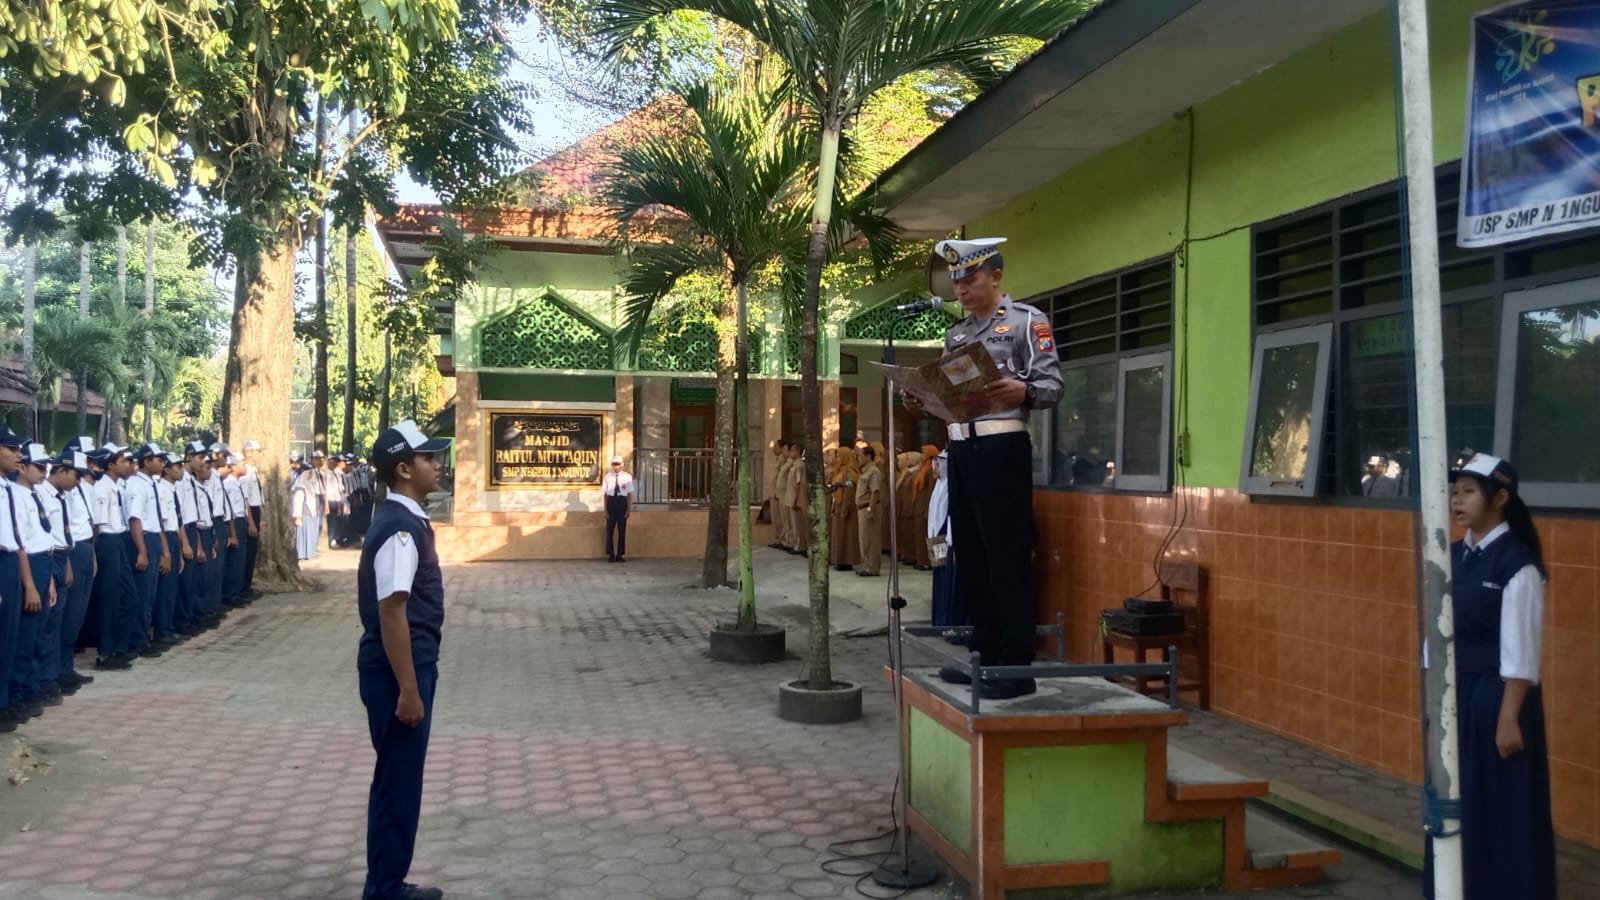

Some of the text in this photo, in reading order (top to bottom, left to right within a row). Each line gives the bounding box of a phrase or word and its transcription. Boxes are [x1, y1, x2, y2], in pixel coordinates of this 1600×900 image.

[1473, 215, 1502, 235] USP
[1505, 207, 1539, 229] SMP
[1542, 203, 1555, 222] N
[986, 335, 1014, 343] POLRI
[524, 435, 570, 447] MASJID
[496, 449, 536, 464] BAITUL
[502, 466, 520, 477] SMP
[520, 466, 551, 478] NEGERI
[558, 467, 591, 478] NGUNUT
